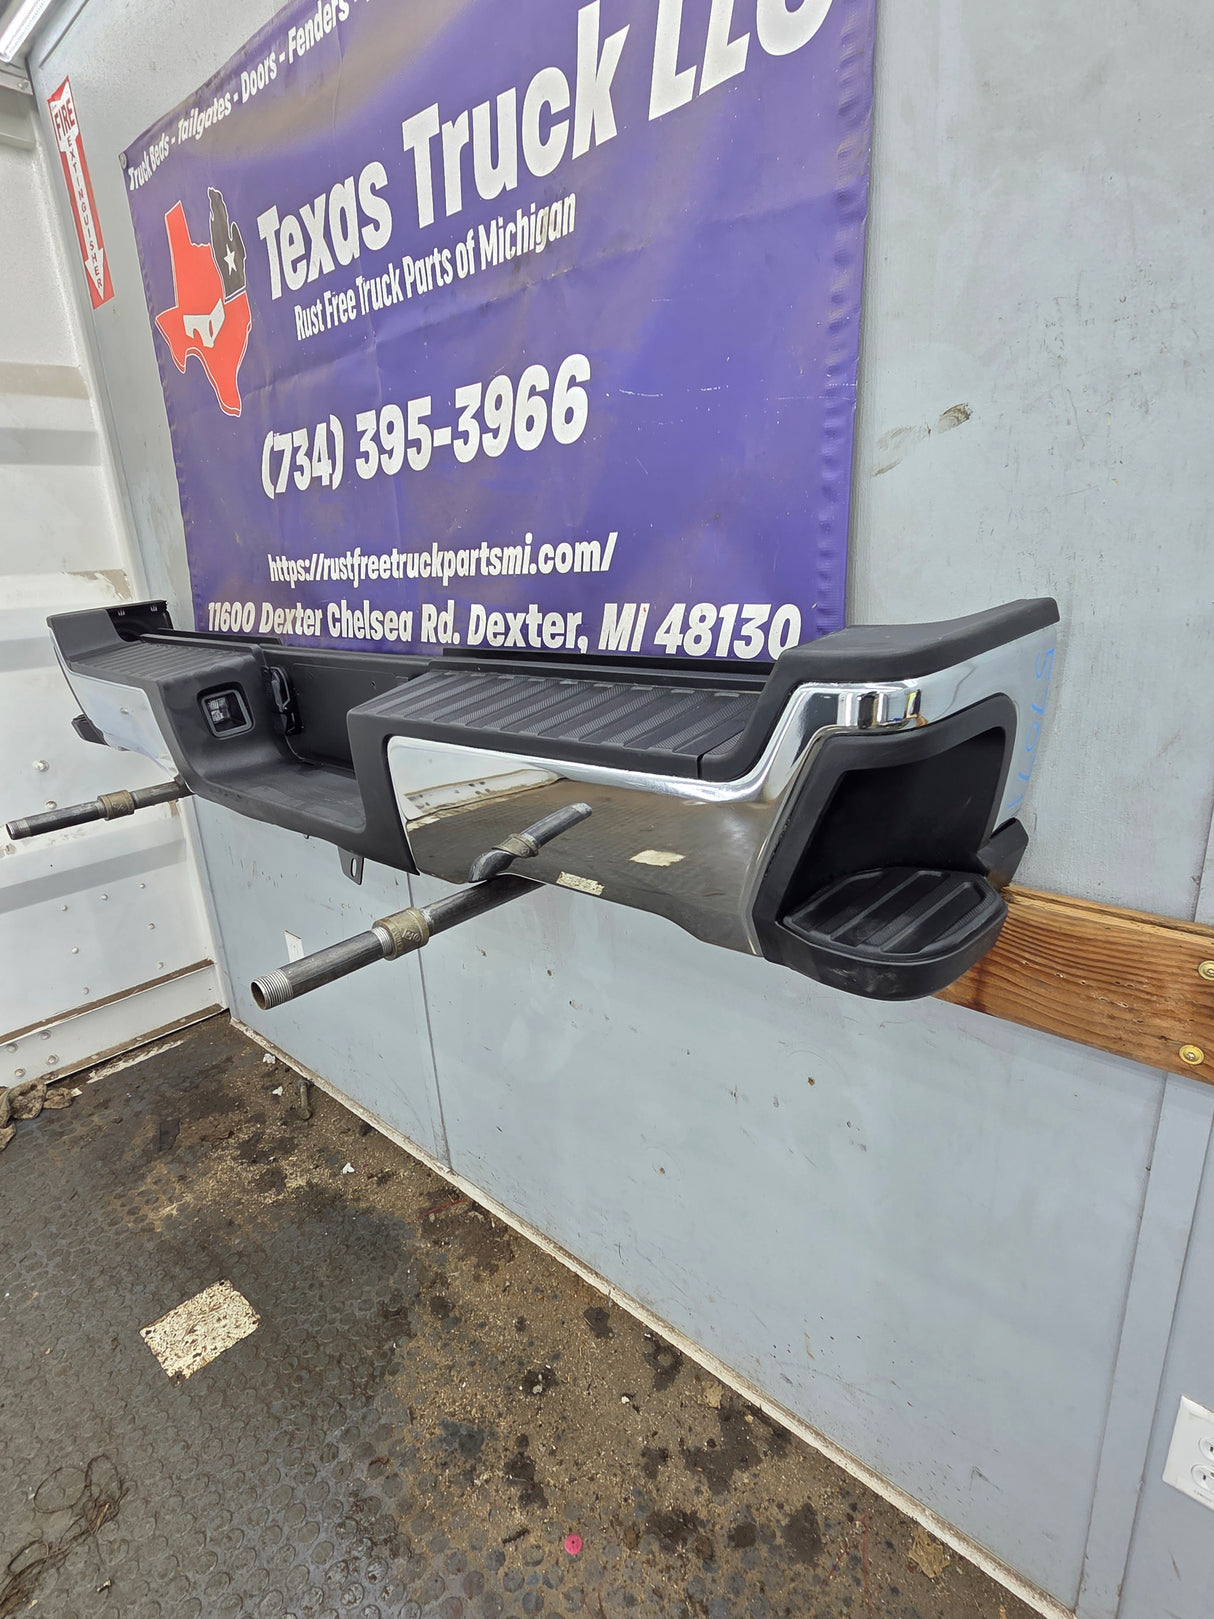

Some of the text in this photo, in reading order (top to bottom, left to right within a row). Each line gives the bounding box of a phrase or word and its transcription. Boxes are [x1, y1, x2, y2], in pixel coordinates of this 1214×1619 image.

[54, 97, 75, 141] FIRE
[128, 151, 152, 191] Truck
[149, 133, 170, 172] Beds
[178, 92, 231, 144] Tailgates
[241, 52, 277, 104] Doors
[288, 0, 350, 64] Fenders
[257, 161, 392, 300] Texas
[402, 0, 630, 229] Truck
[66, 135, 103, 289] EXTINGUISHER
[294, 193, 577, 341] Rust Free Truck Parts of Michigan
[261, 353, 591, 500] (734) 395-3966
[208, 600, 801, 661] 11600 Dexter Chelsea Rd. Dexter, MI 48130
[268, 531, 618, 589] https://rustfreetruckpartsmi.com/
